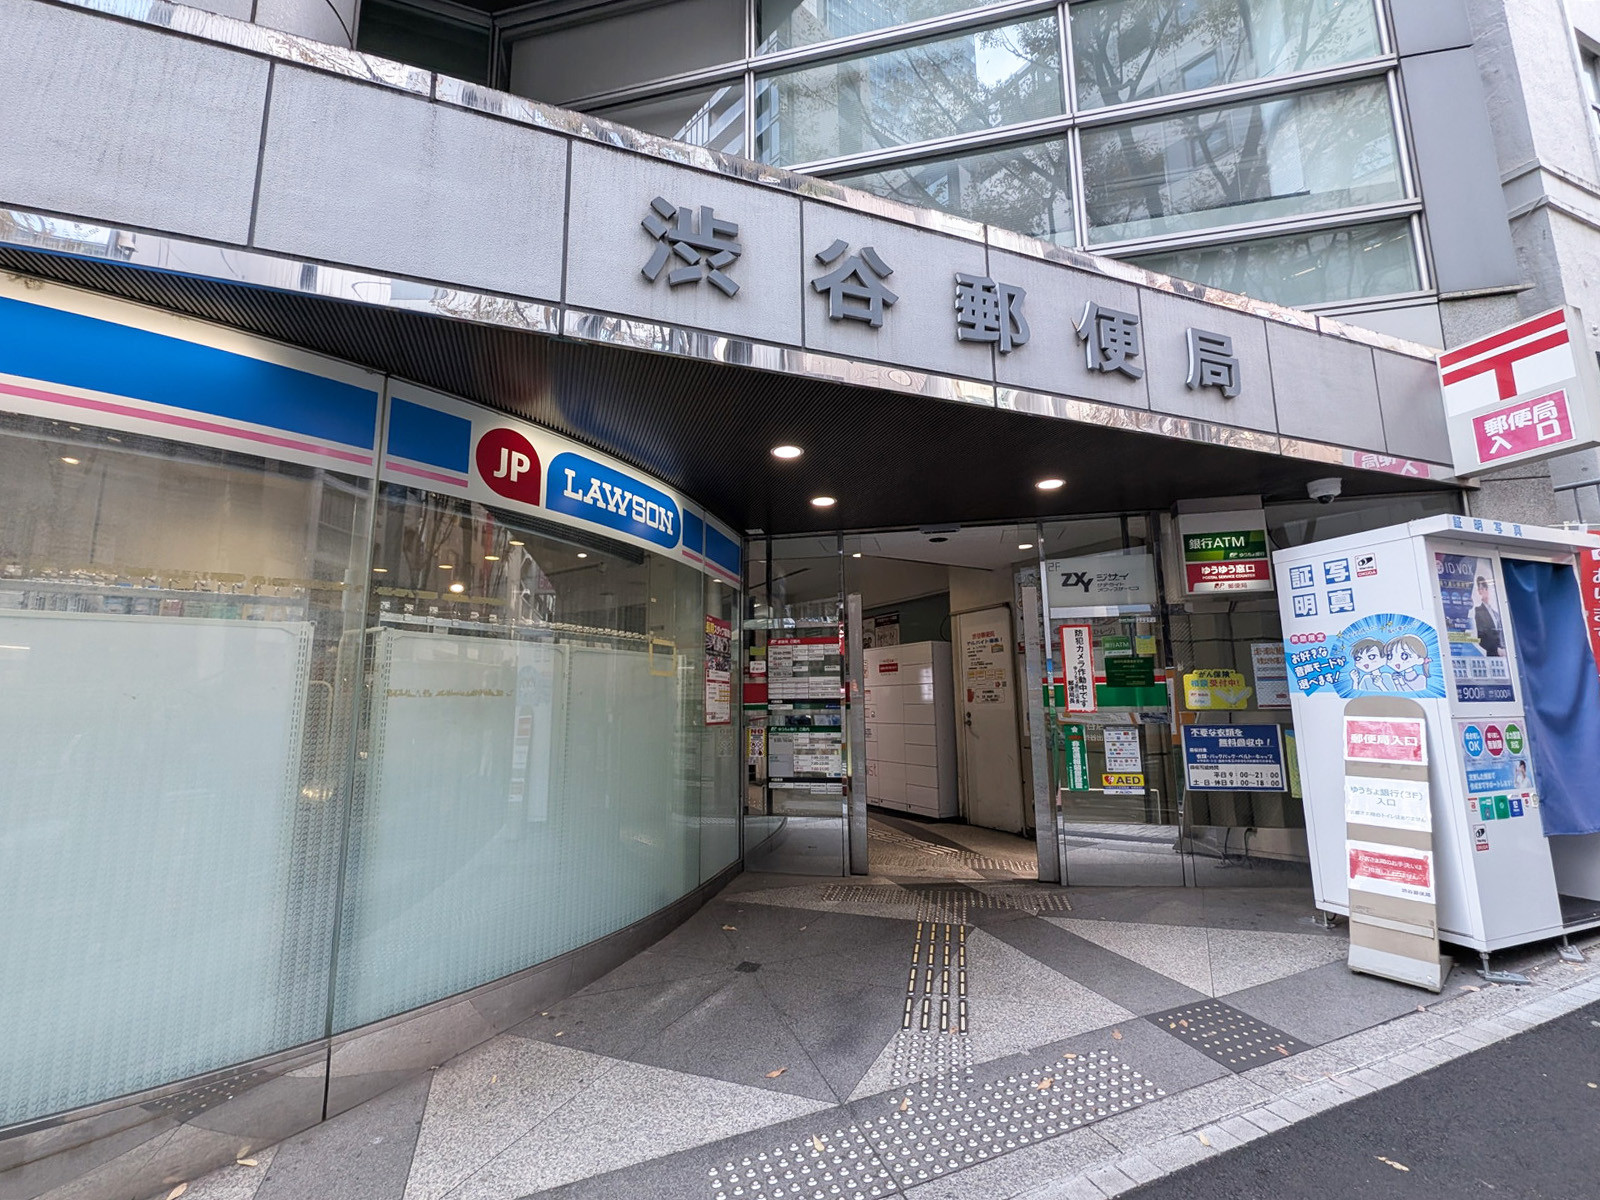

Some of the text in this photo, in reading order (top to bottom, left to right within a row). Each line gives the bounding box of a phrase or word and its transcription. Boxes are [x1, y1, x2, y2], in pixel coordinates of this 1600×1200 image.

[641, 196, 1242, 399] 渋谷郵便局
[1483, 400, 1558, 437] 郵便局
[1489, 421, 1562, 454] 入口
[493, 447, 531, 483] JP
[563, 467, 674, 536] LAWSON
[1453, 515, 1523, 538] 証明写真
[1189, 536, 1245, 550] 銀行ATM
[1048, 562, 1061, 572] 2F
[1201, 564, 1256, 575] ゆうゆう窓口
[1061, 571, 1094, 593] ZXY
[1291, 632, 1325, 643] 期間限定
[1291, 646, 1329, 665] お好きな
[1073, 629, 1088, 708] 防犯カメラ作動中です
[1294, 656, 1347, 677] 音声モードが
[1298, 671, 1341, 690] 選べます!
[1190, 728, 1244, 737] 不要な衣類を
[1350, 733, 1419, 747] 郵便局入口
[1218, 738, 1271, 748] 無料回収中!
[1468, 741, 1481, 751] OK
[1116, 776, 1141, 785] AED
[1376, 797, 1396, 807] 入口
